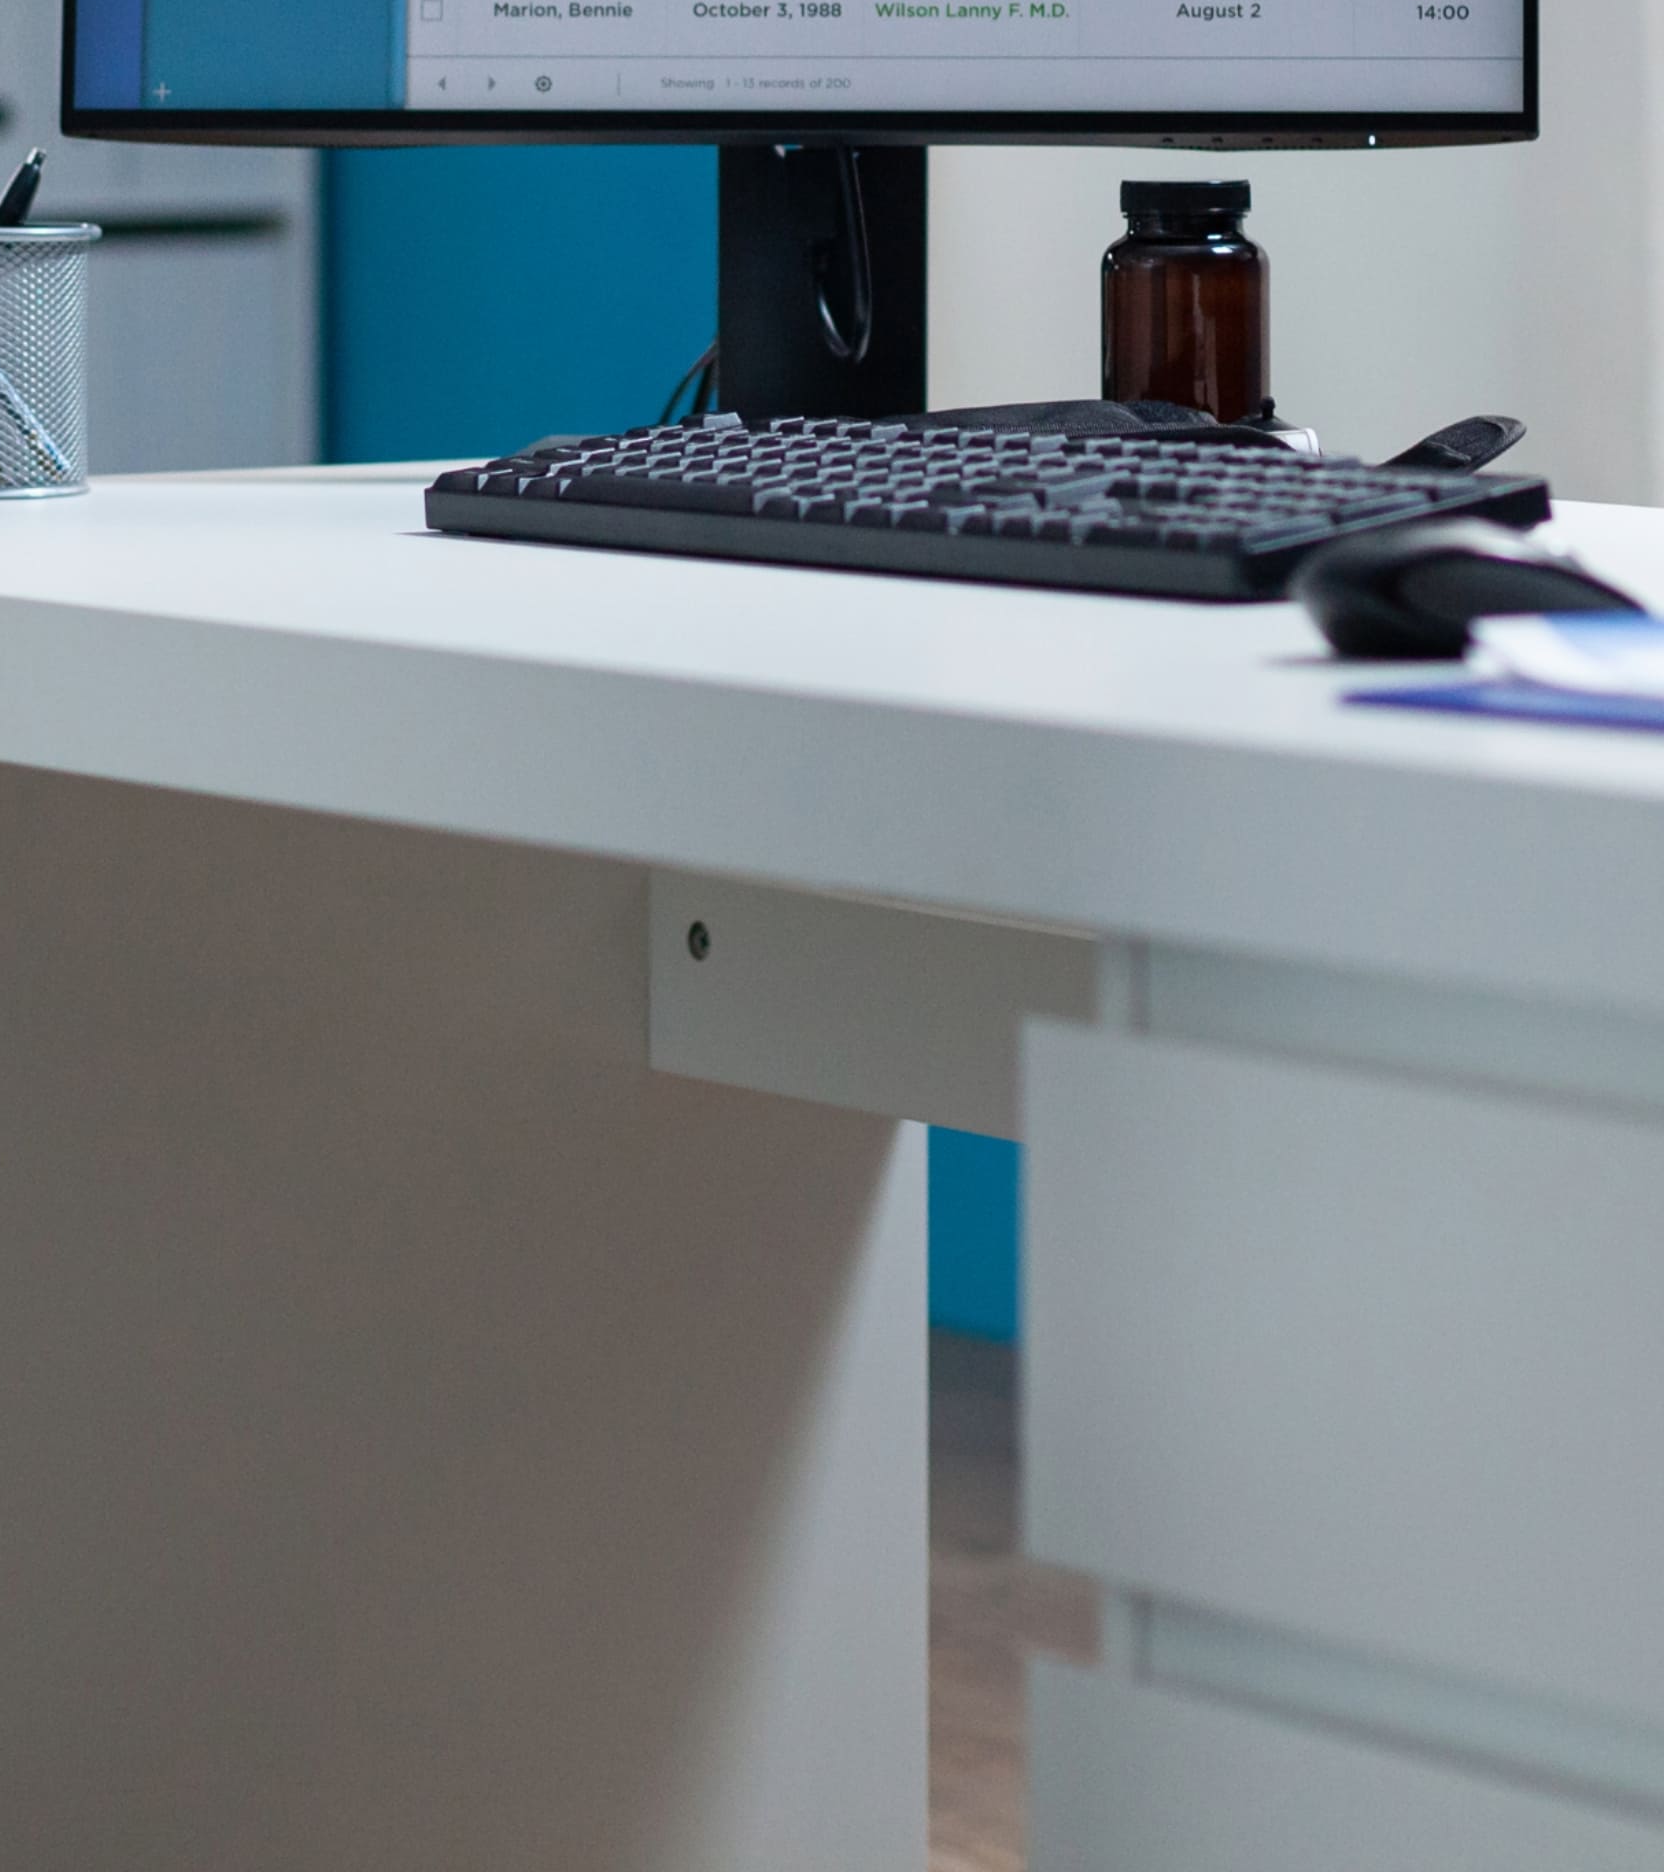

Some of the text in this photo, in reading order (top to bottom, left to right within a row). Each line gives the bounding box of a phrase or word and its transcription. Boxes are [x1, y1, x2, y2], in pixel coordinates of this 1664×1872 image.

[493, 1, 634, 19] Marion, Bennie
[692, 1, 843, 20] October 3, 1988
[874, 2, 1069, 21] Wilson Lanny F. M.D.
[1176, 2, 1262, 22] August 2
[1416, 4, 1470, 21] 14:00
[660, 77, 715, 91] Showing
[758, 78, 806, 89] records
[809, 77, 823, 89] of
